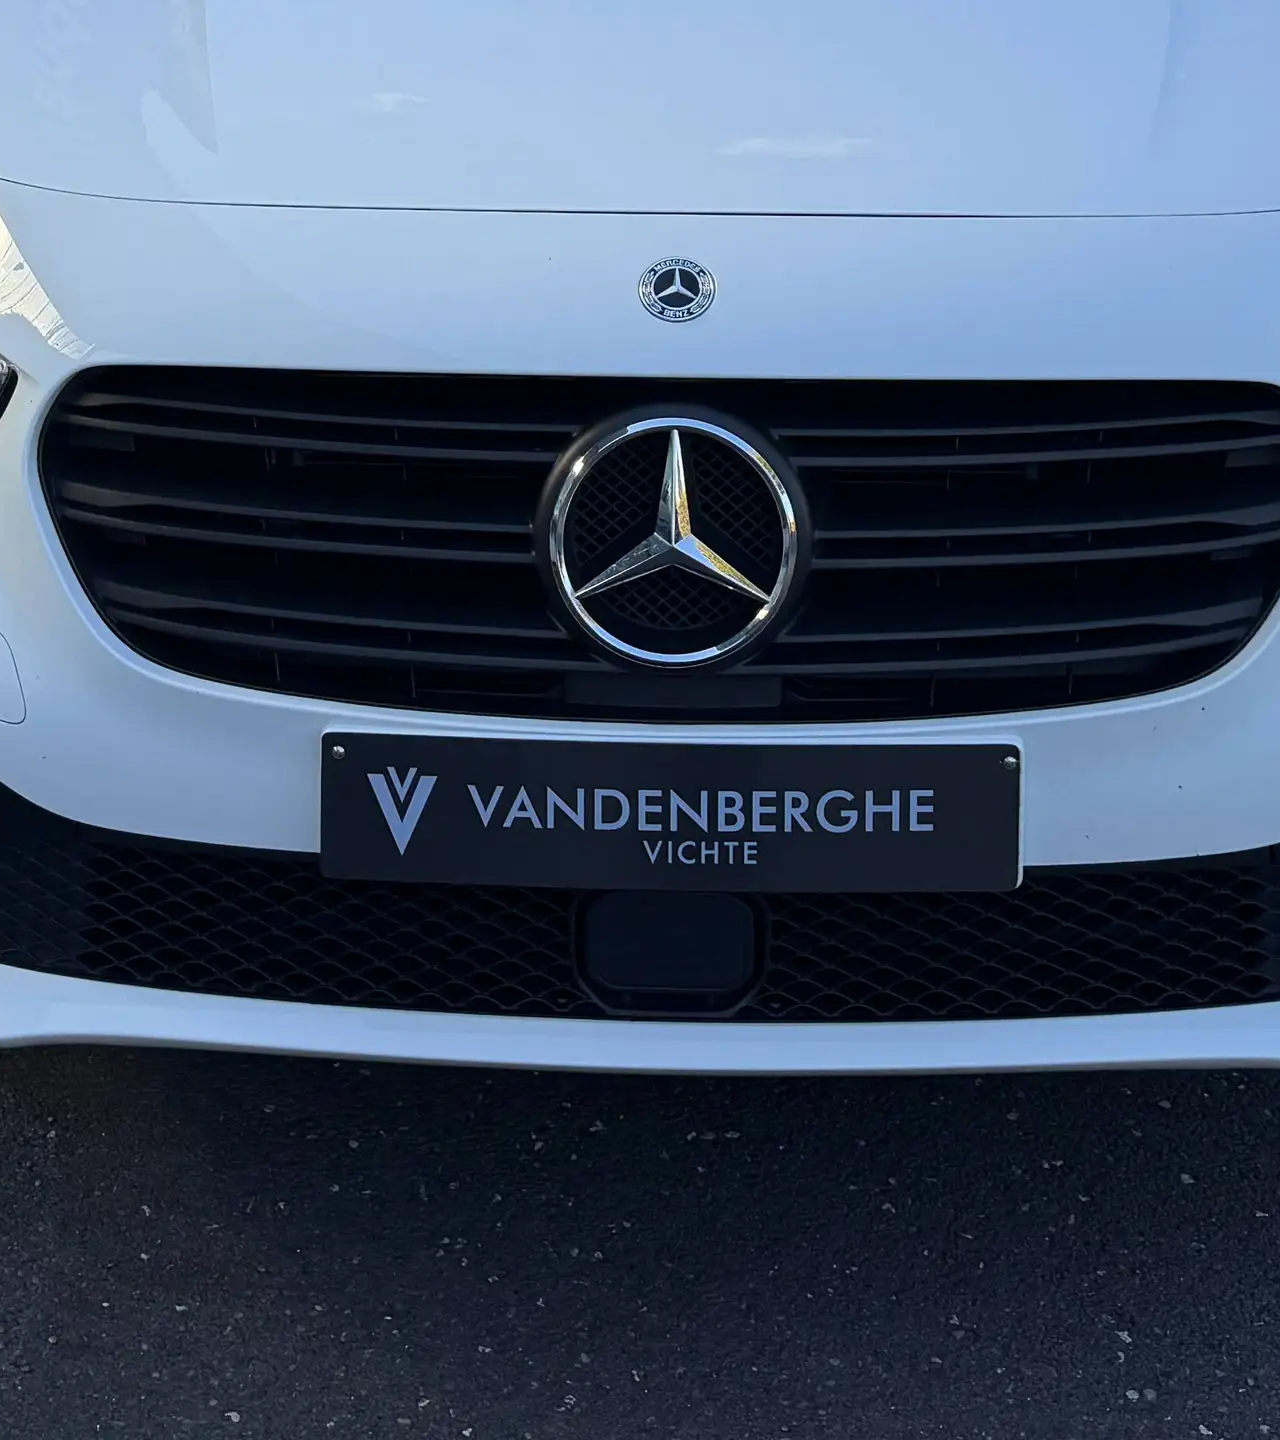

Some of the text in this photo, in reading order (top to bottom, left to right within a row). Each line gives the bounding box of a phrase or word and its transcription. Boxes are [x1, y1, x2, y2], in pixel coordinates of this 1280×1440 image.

[653, 259, 701, 273] MERCEDES
[663, 308, 690, 318] BENZ
[467, 783, 936, 834] VANDENBERGHE
[643, 840, 759, 865] VICHTE
